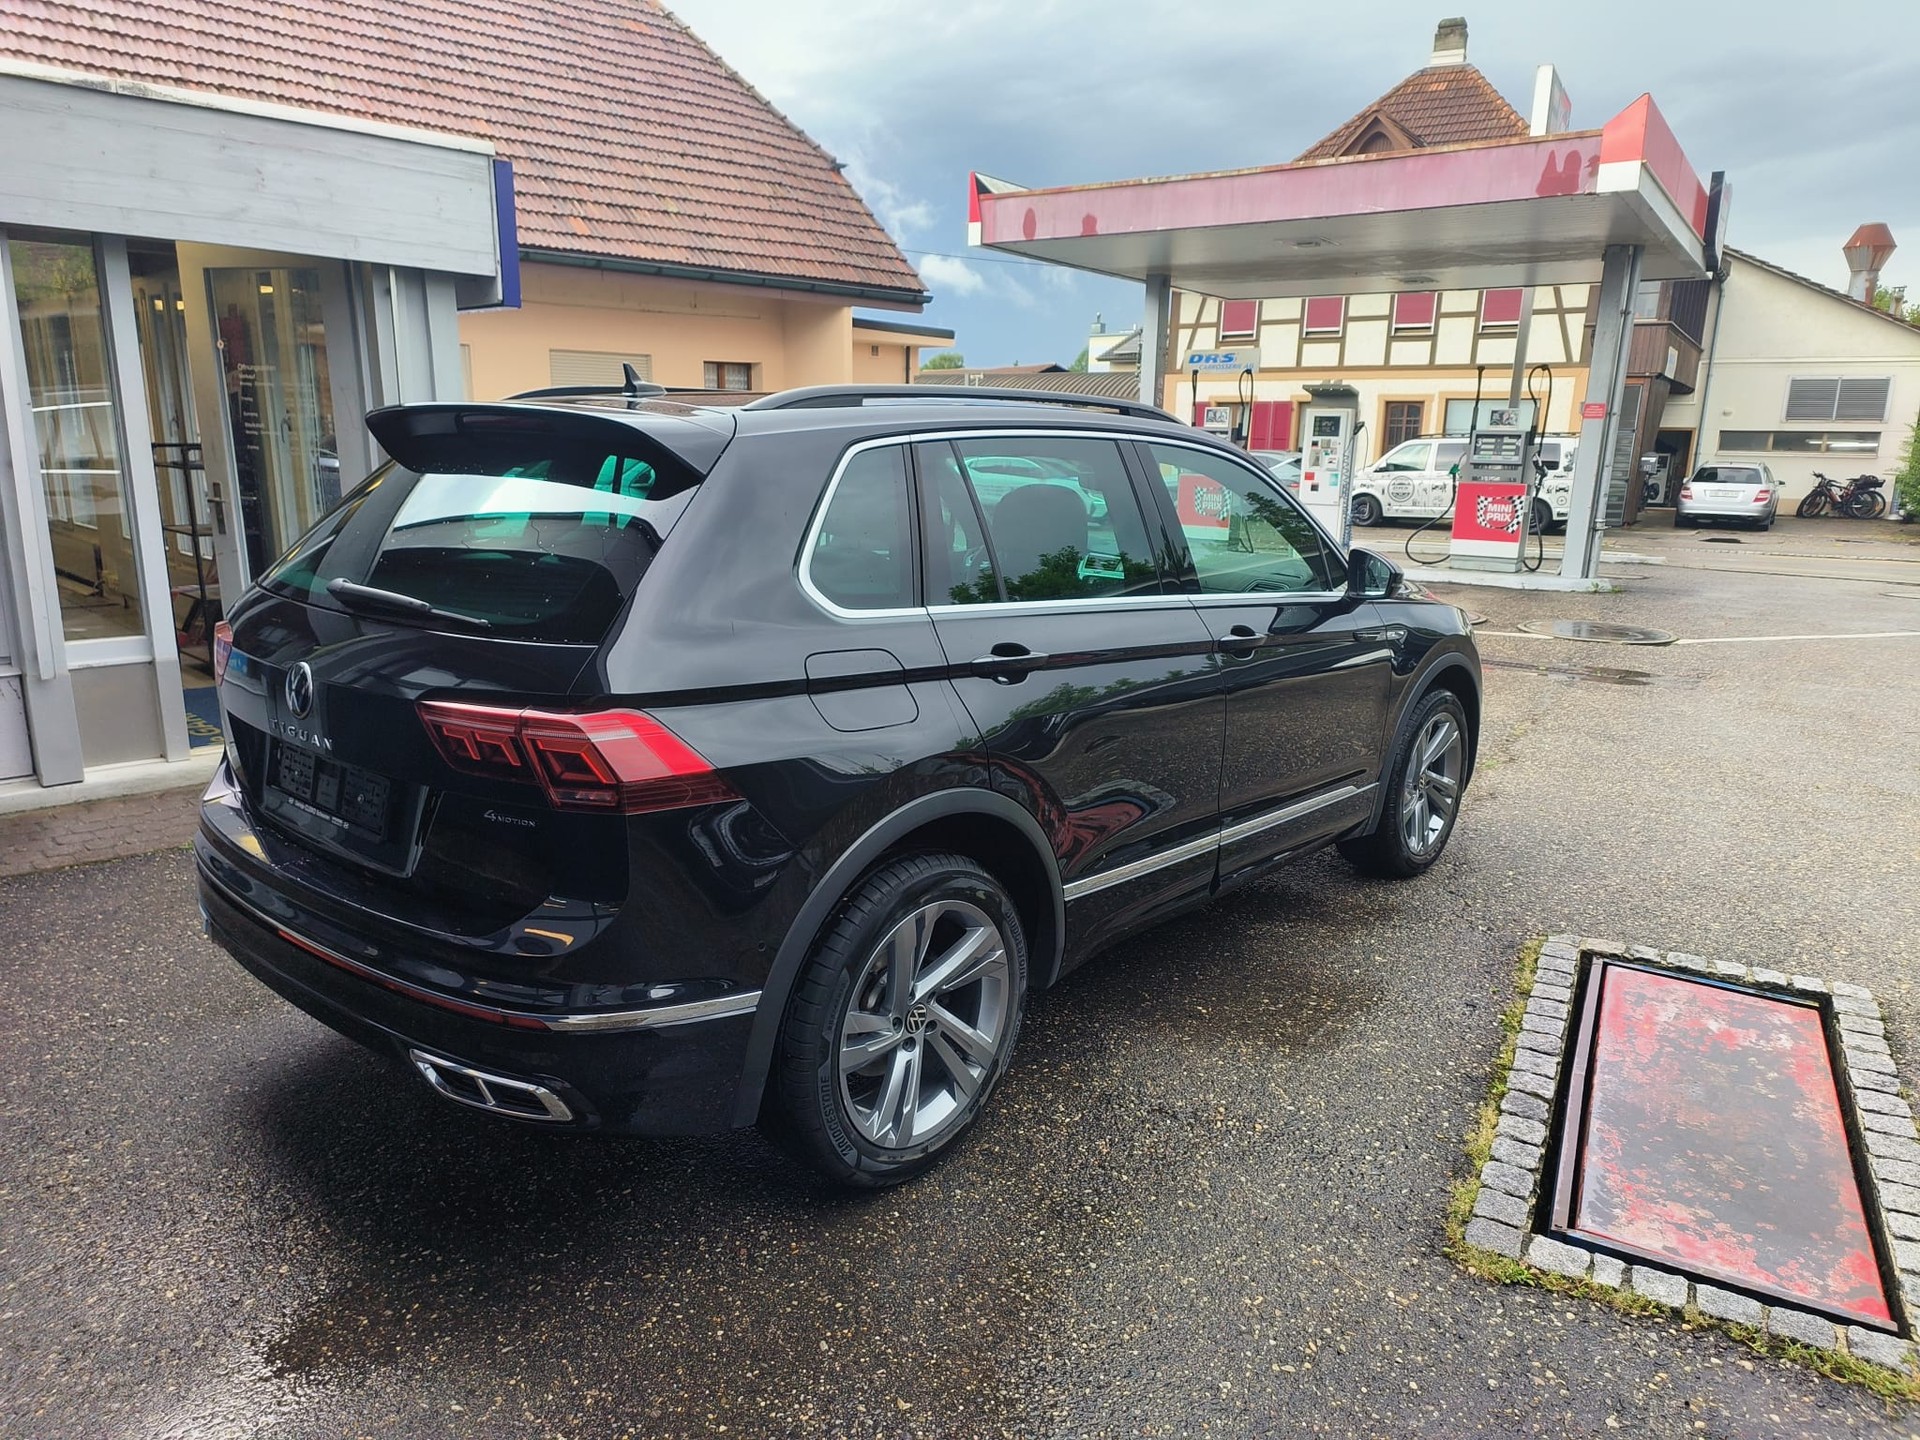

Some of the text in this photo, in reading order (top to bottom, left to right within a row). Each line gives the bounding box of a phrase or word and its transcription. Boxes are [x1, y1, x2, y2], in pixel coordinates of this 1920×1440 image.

[1189, 352, 1236, 363] DRS
[1202, 494, 1222, 502] MINI
[1202, 501, 1222, 510] PRIX
[1487, 503, 1512, 513] MINI
[1486, 513, 1512, 522] PRIX
[269, 719, 333, 750] TIGUAN
